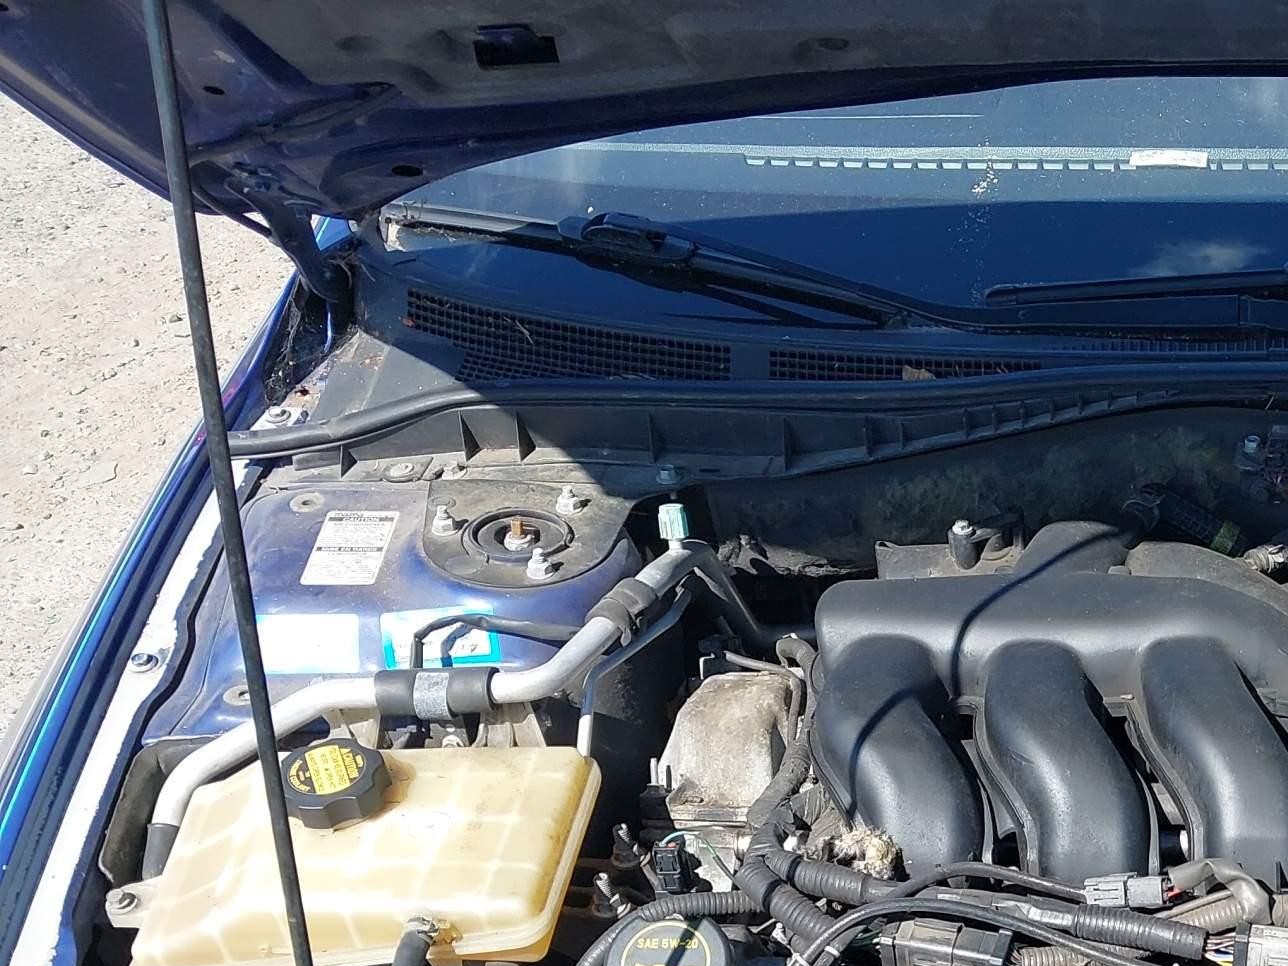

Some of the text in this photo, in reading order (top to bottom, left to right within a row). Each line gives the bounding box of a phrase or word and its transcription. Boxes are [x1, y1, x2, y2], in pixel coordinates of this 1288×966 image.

[343, 750, 360, 779] CAUTION
[635, 938, 699, 950] SAE 5W-20
